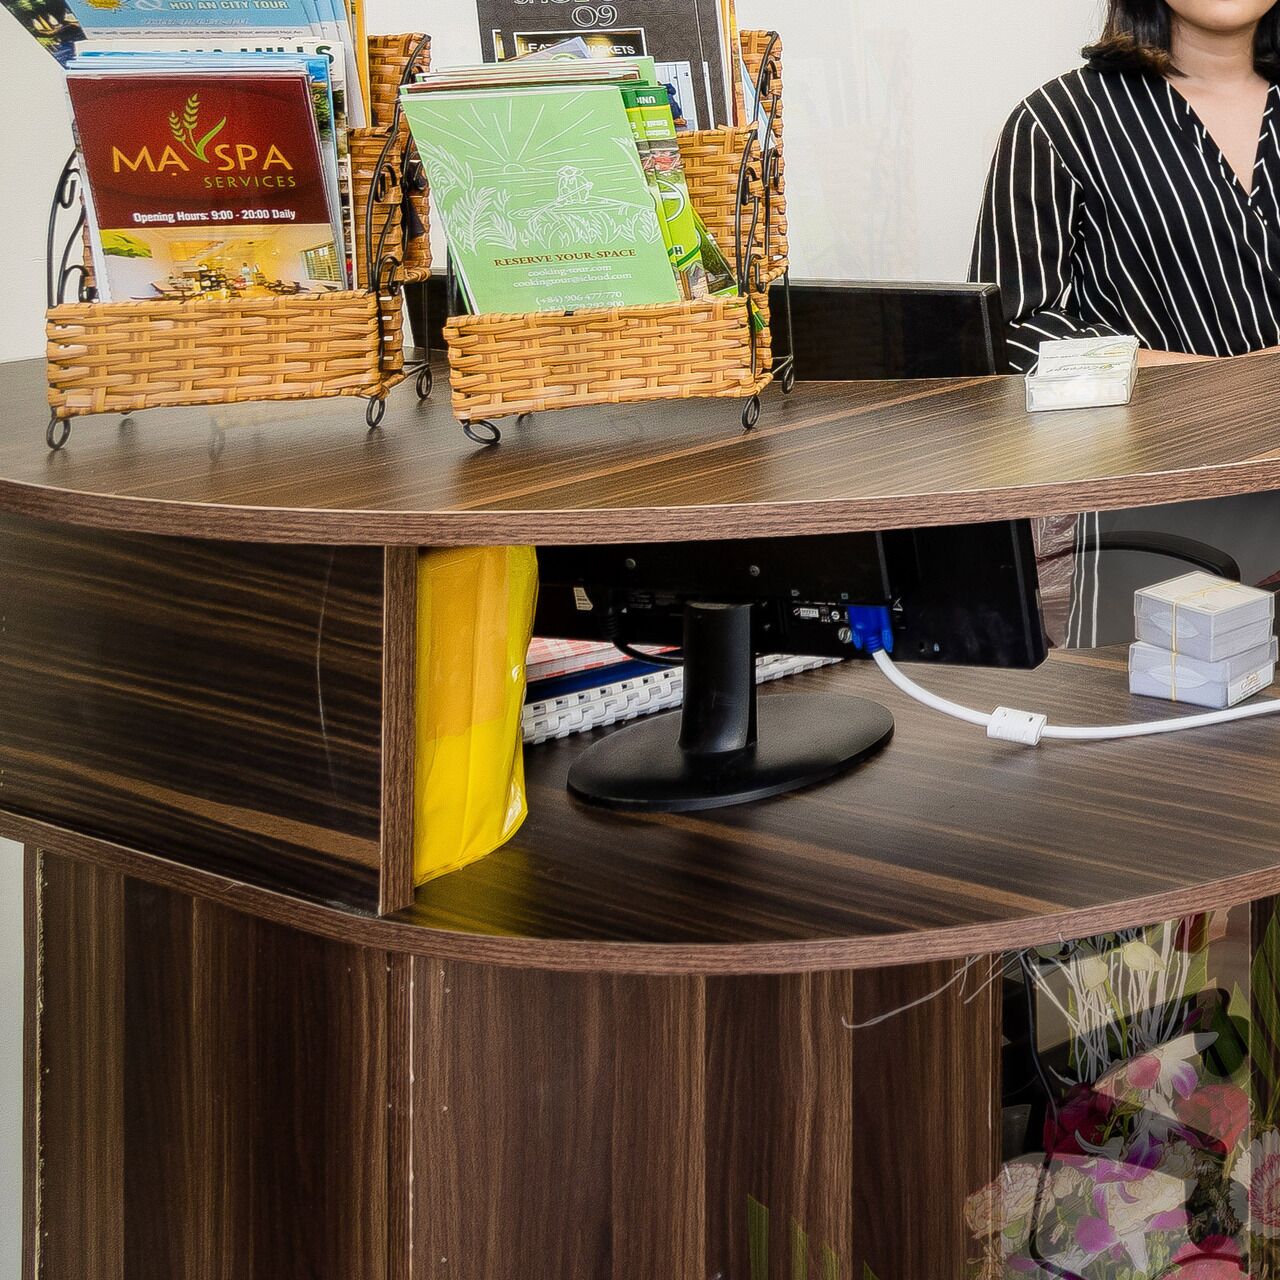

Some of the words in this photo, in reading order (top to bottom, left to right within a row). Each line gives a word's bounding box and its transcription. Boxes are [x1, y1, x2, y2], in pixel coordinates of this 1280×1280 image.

[198, 1, 217, 10] AN
[220, 0, 249, 9] CITY
[253, 0, 289, 9] TOUR
[571, 4, 618, 27] 09
[213, 143, 294, 171] SPA
[204, 176, 297, 189] SERVICES
[132, 211, 176, 224] Opening
[176, 210, 209, 221] Hours:
[211, 210, 233, 220] 9:00
[242, 209, 269, 219] 20:00
[272, 209, 296, 220] Daily
[493, 256, 553, 267] RESERVE
[554, 252, 594, 262] YOUR
[596, 248, 637, 258] SPACE
